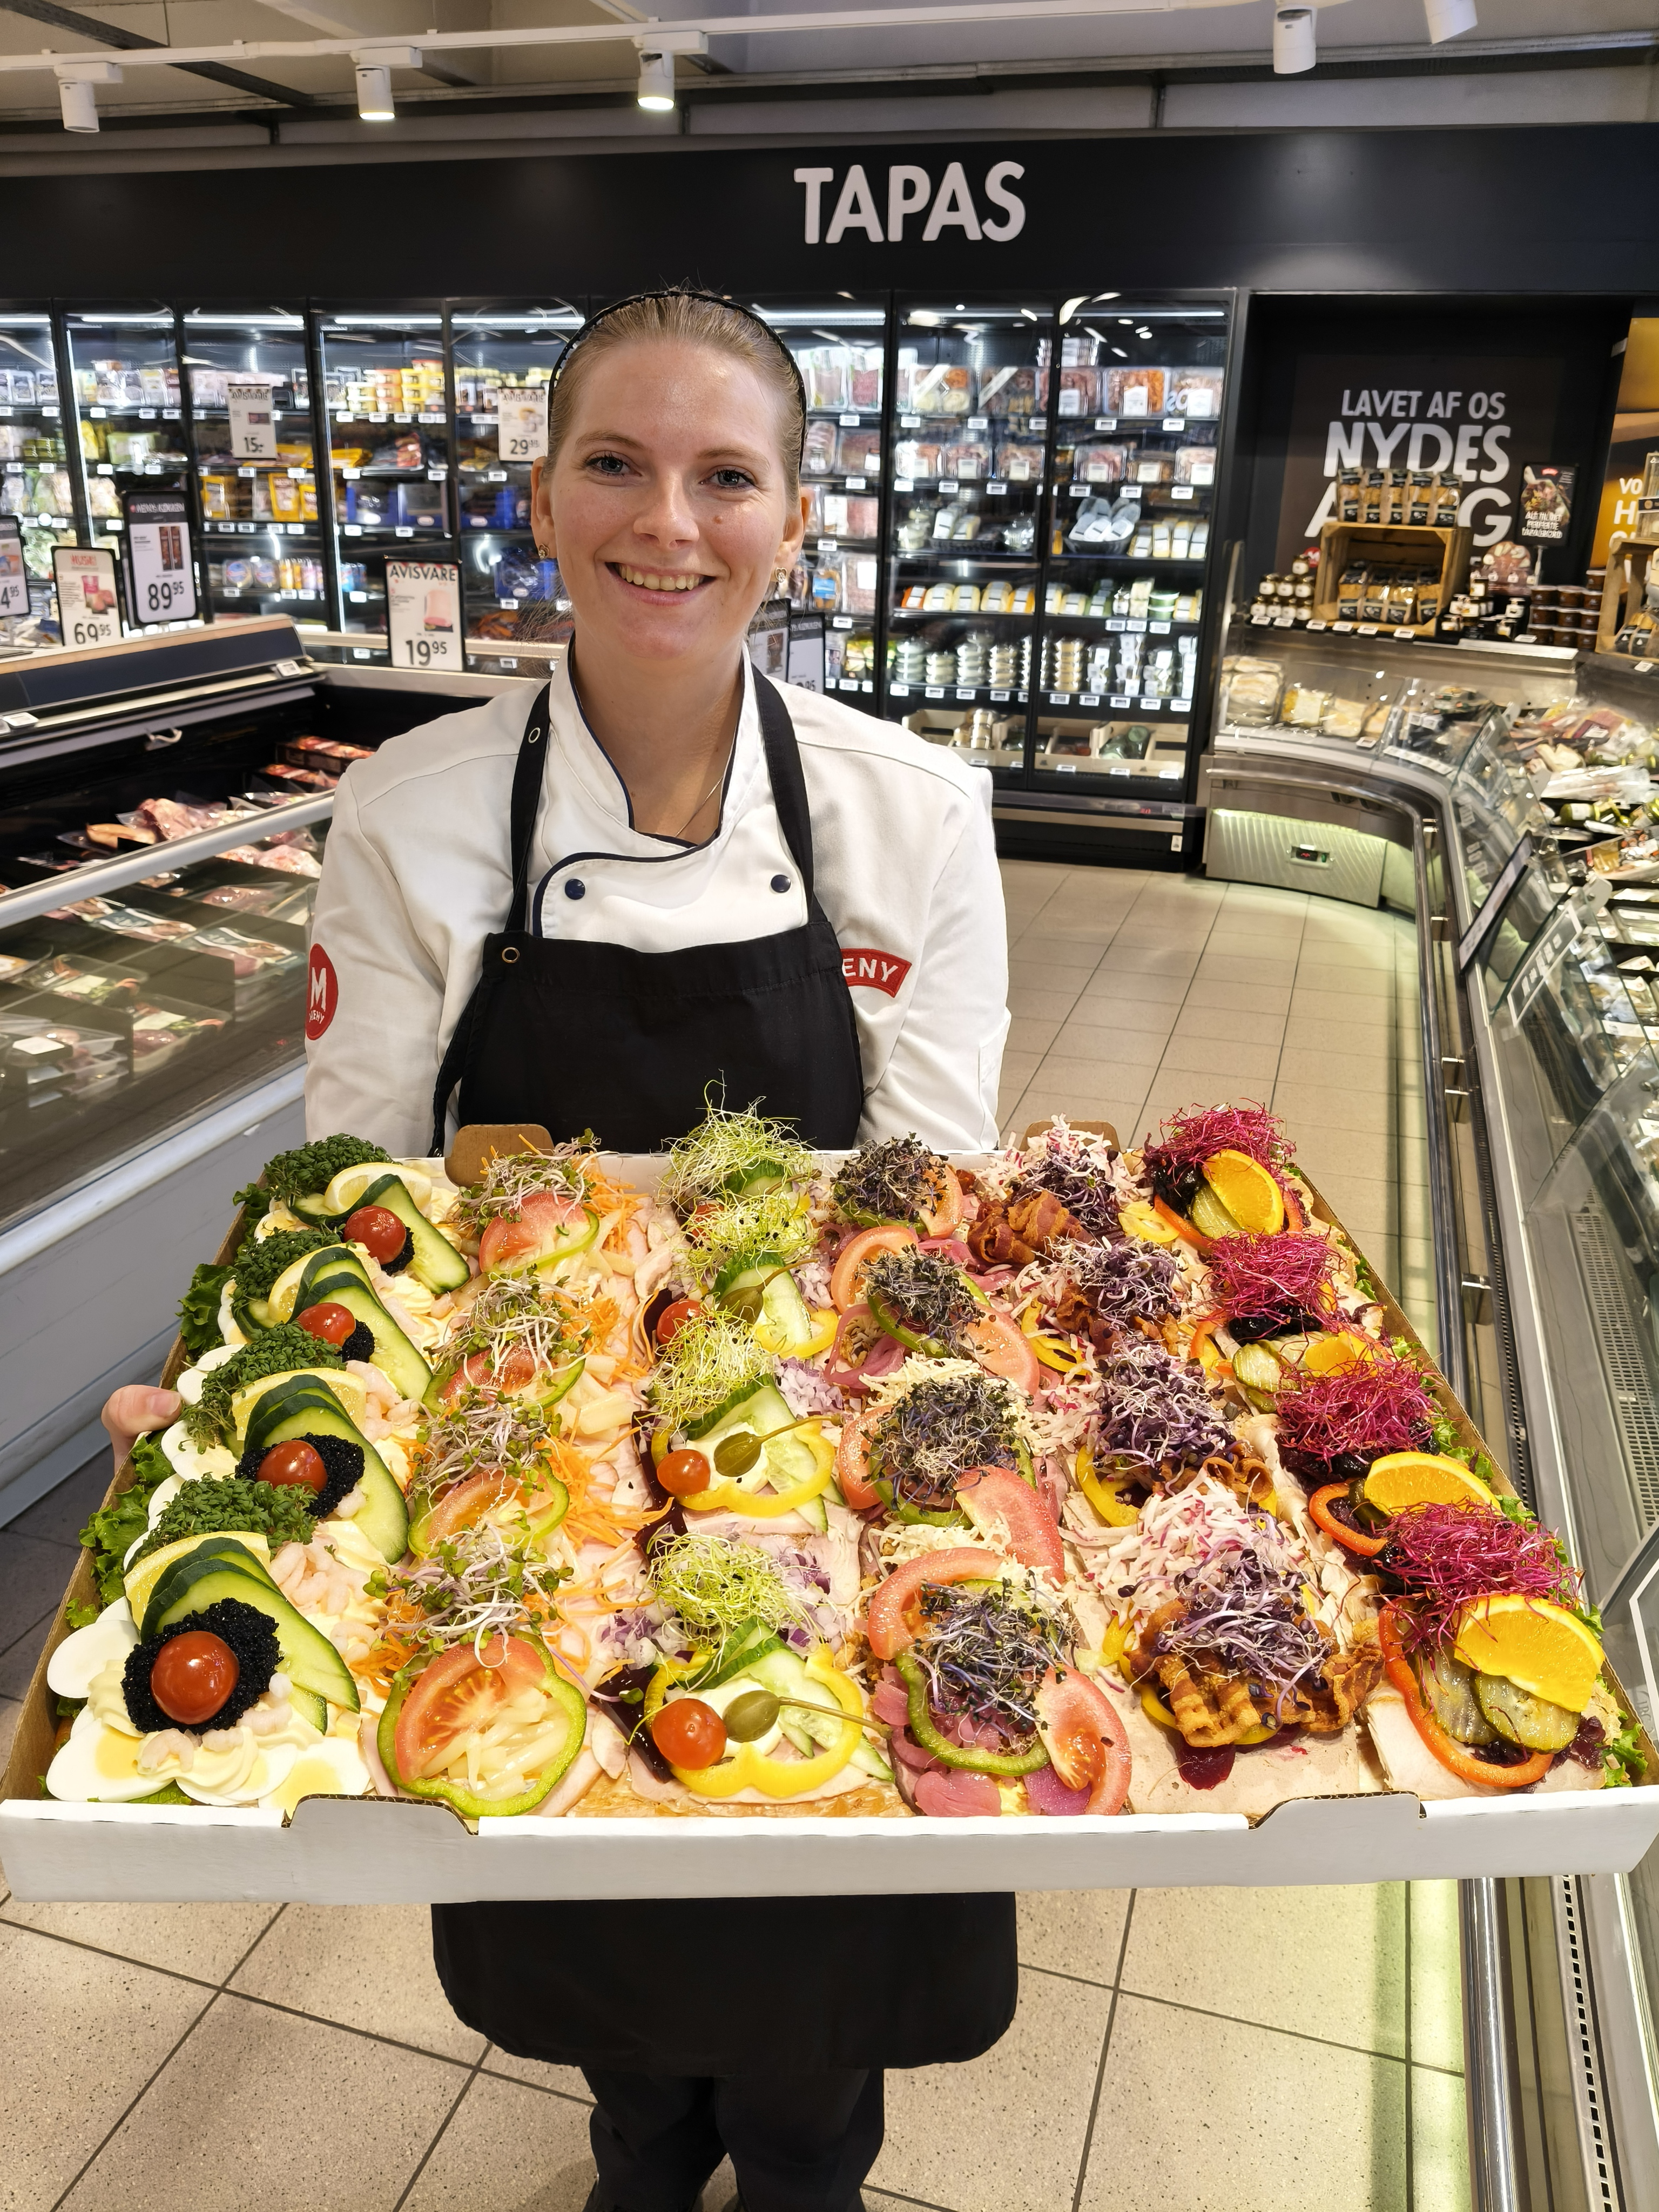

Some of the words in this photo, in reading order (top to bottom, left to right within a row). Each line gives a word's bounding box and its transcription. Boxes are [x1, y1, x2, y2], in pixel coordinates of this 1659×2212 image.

[794, 160, 1026, 244] TAPAS
[1341, 389, 1424, 417] LAVET
[1426, 391, 1462, 418] AF
[1468, 392, 1506, 420] OS
[1323, 421, 1512, 484] NYDES
[1619, 477, 1643, 495] VO
[390, 564, 456, 582] AVISVARE
[841, 957, 899, 982] ENY
[310, 967, 327, 1012] M
